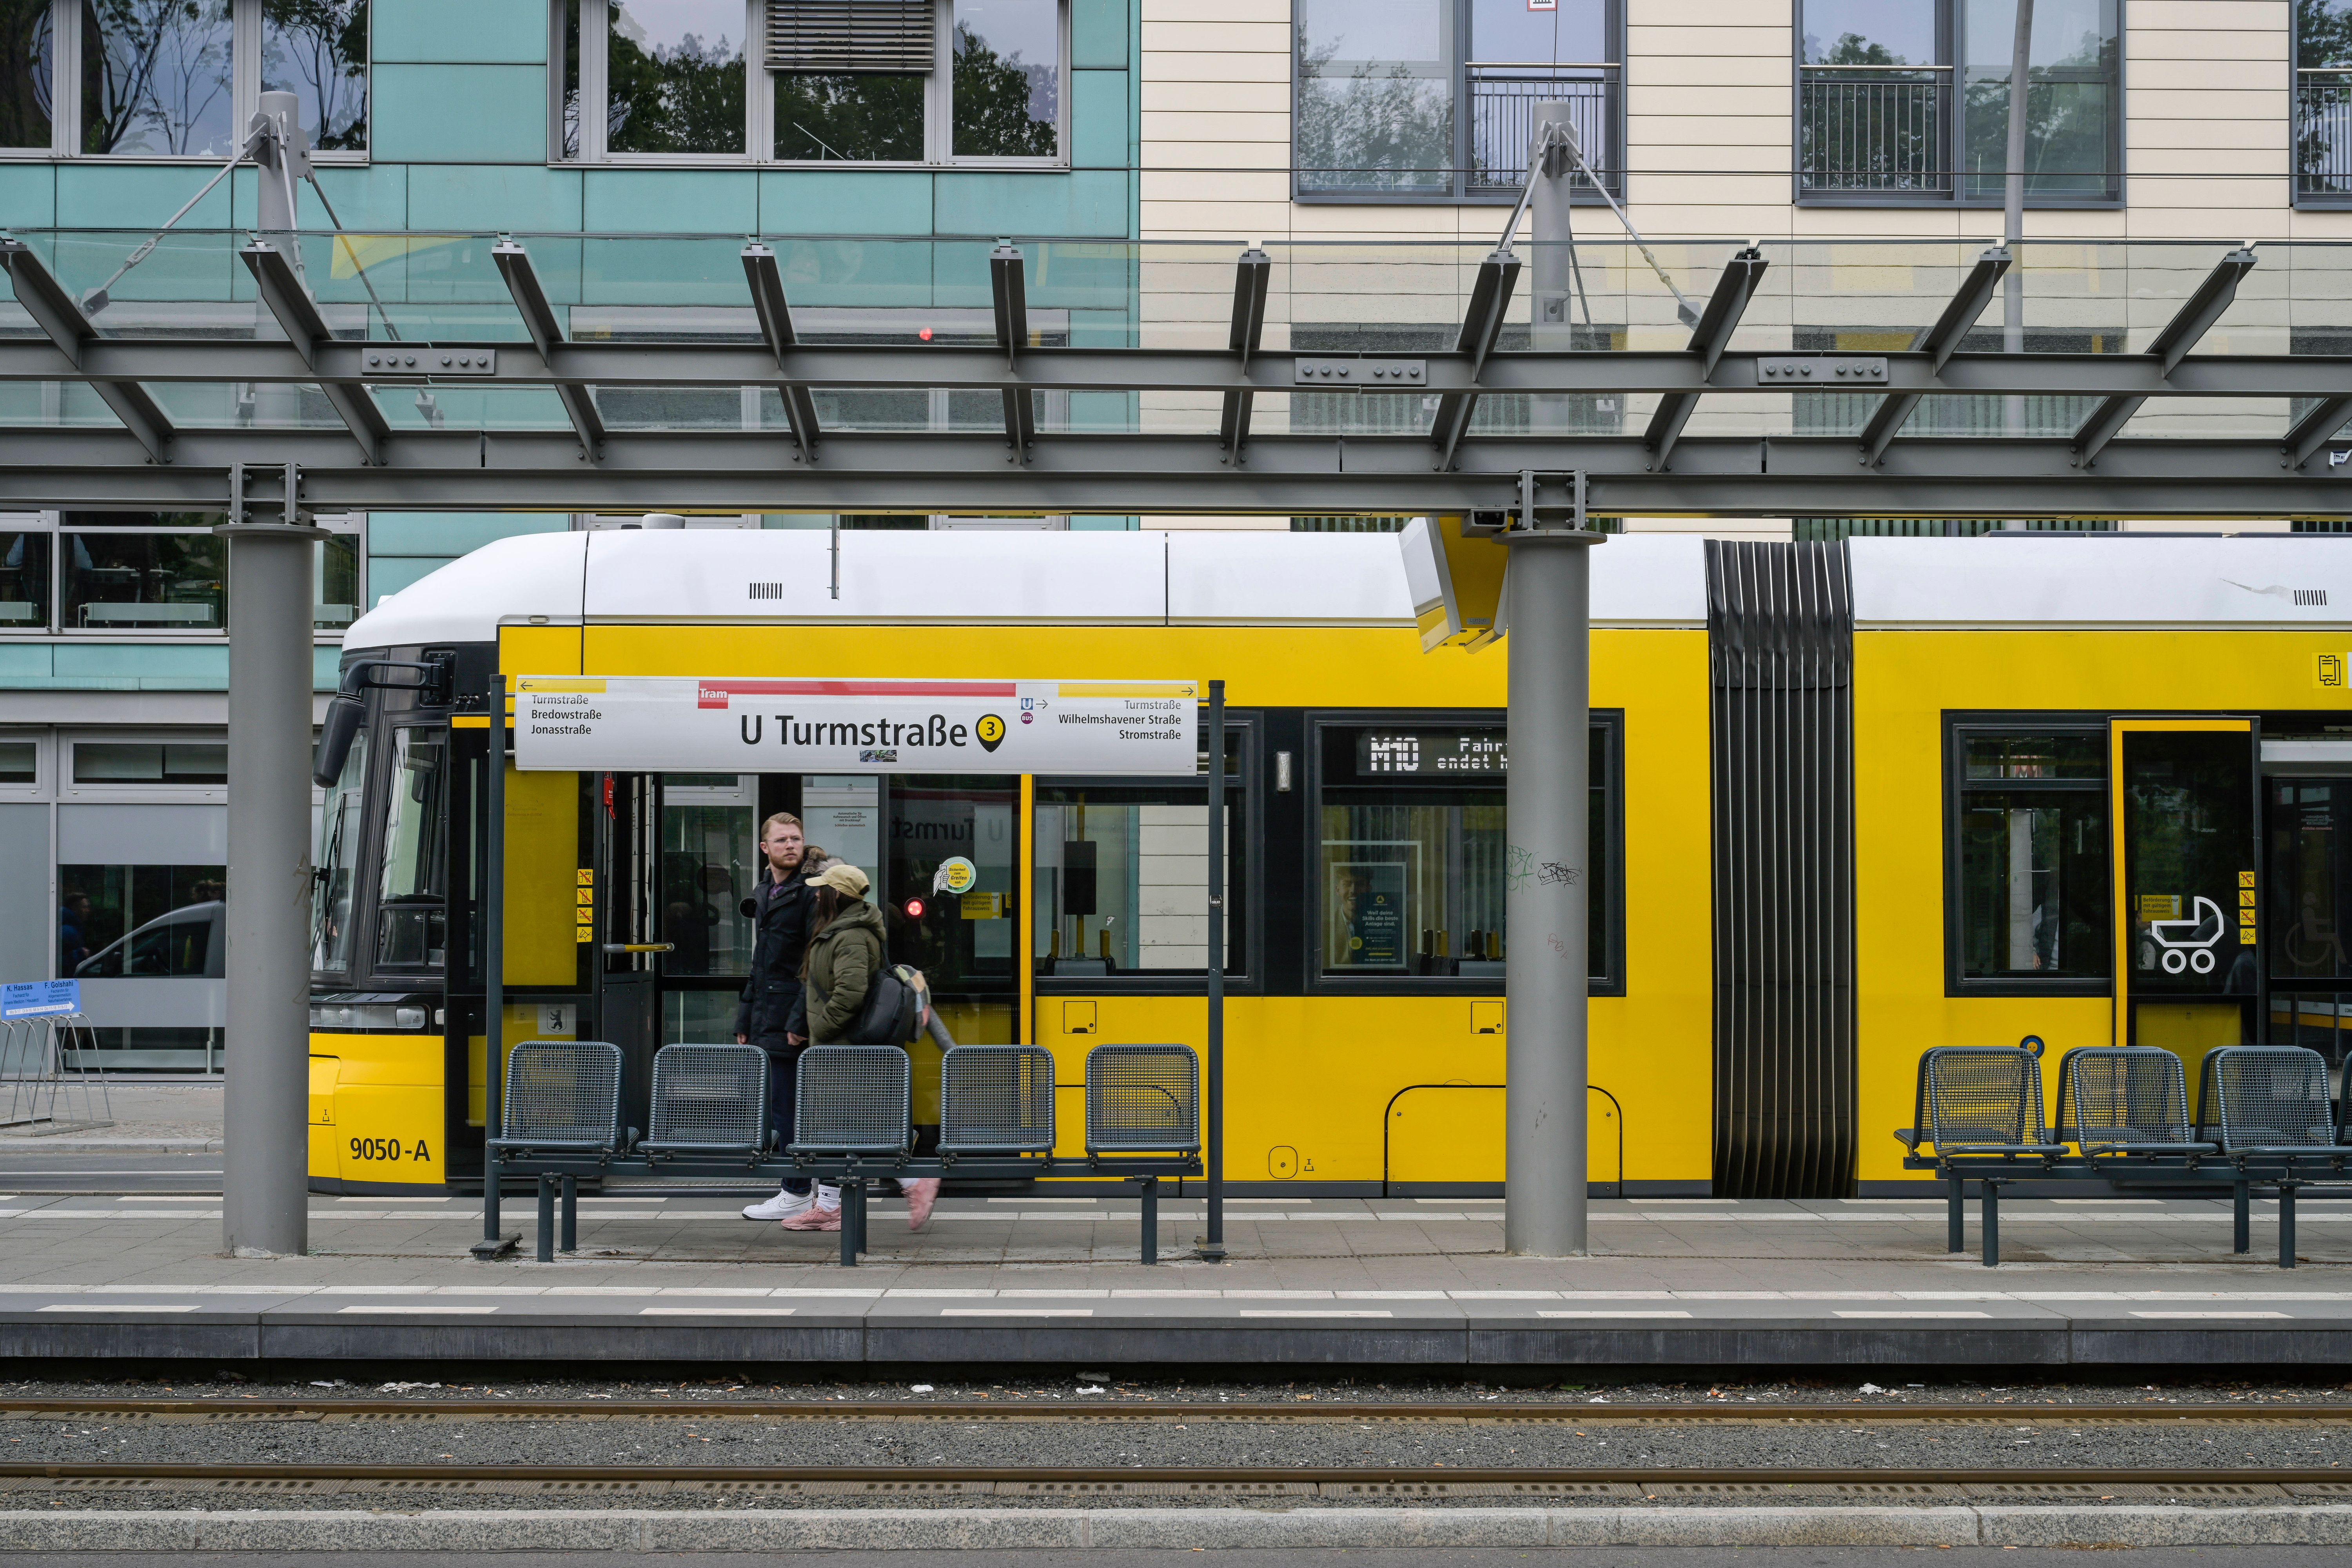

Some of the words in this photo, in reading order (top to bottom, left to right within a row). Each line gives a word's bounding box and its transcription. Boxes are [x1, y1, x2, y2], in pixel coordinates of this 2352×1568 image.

[532, 695, 589, 704] Turmstraße
[699, 688, 728, 699] Tram
[1125, 700, 1181, 710] Turmstraße
[532, 709, 601, 719] Bredowstraße
[1058, 713, 1146, 725] Wilhelmshavener
[1149, 713, 1181, 725] Straße
[531, 724, 591, 734] Jonasstraße
[741, 715, 762, 745] U
[775, 714, 967, 747] Turmstraße
[987, 722, 995, 736] 3
[1120, 729, 1181, 740] Stromstraße
[1461, 738, 1507, 751] Fahr
[1371, 737, 1418, 771] M10
[1438, 754, 1490, 769] endet
[350, 1137, 430, 1161] 9050-A
